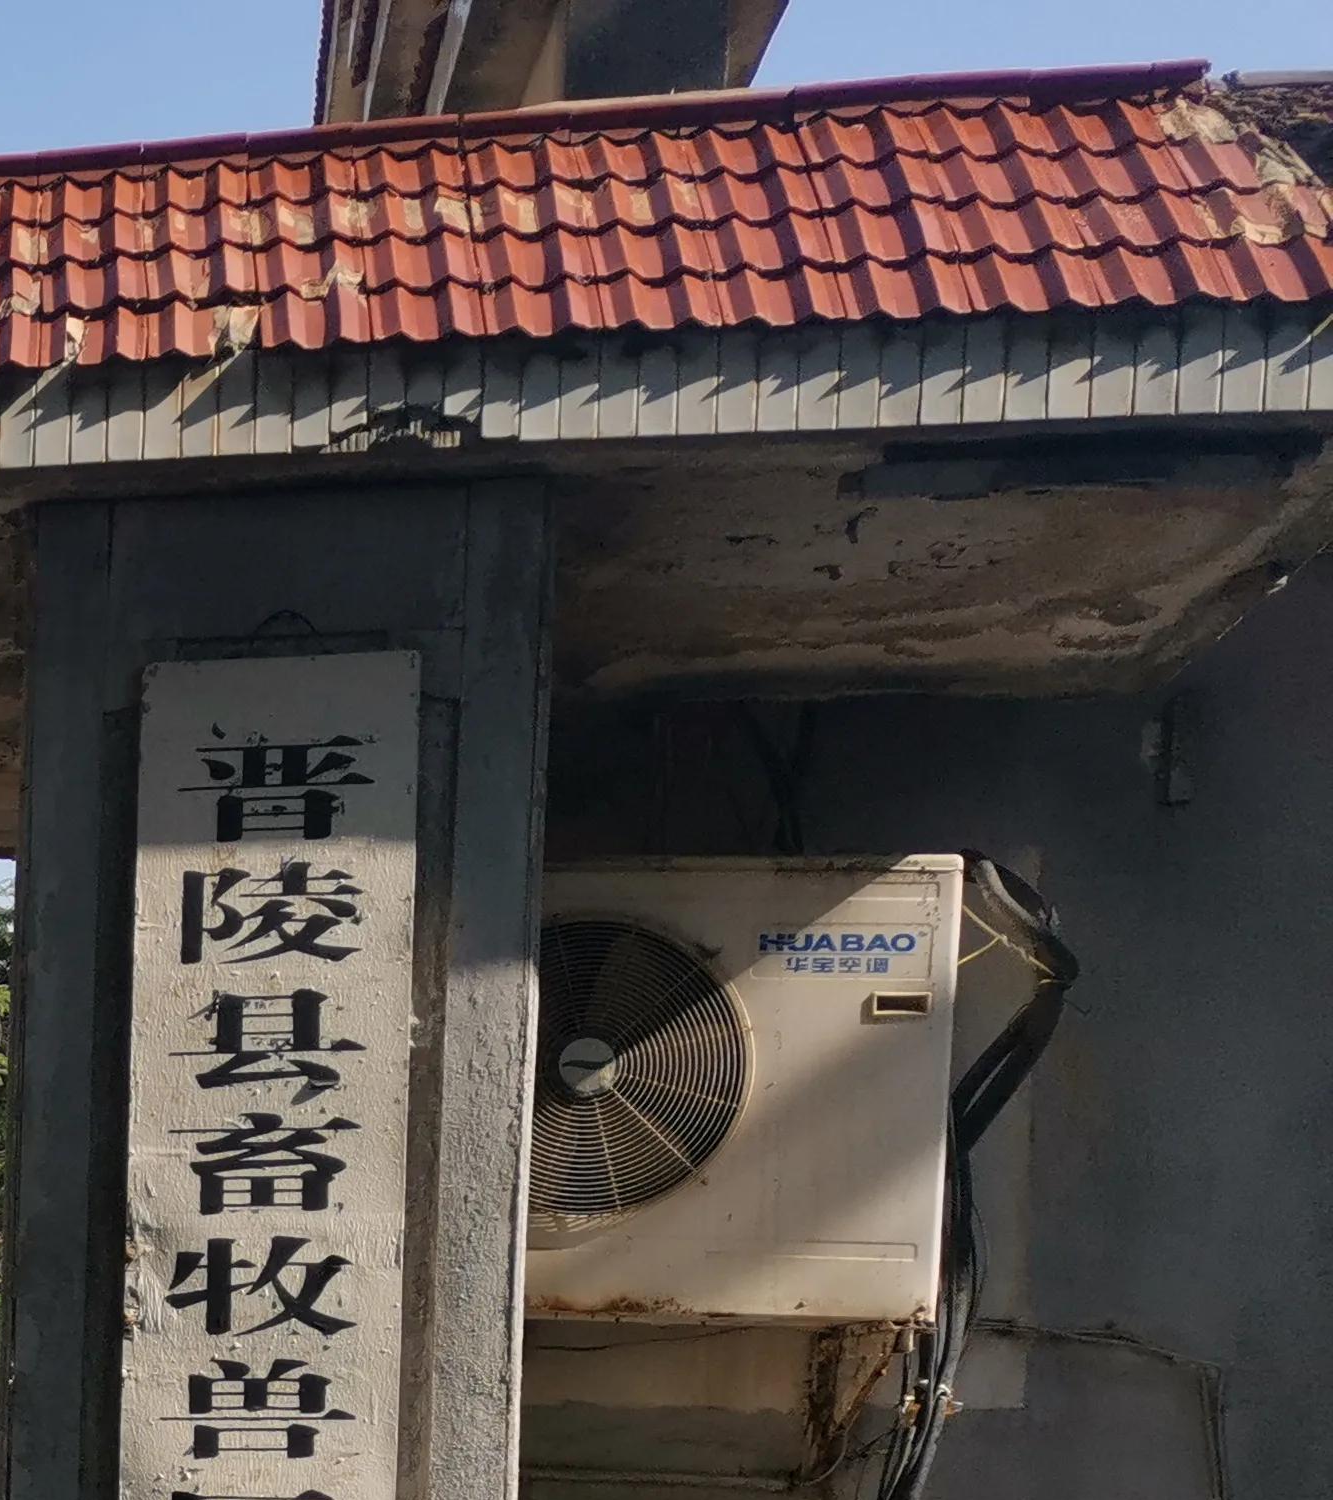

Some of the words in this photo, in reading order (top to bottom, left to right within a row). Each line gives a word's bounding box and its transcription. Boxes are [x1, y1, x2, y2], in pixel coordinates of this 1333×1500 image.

[759, 932, 916, 952] HUABAO
[785, 956, 890, 974] 华宝空调
